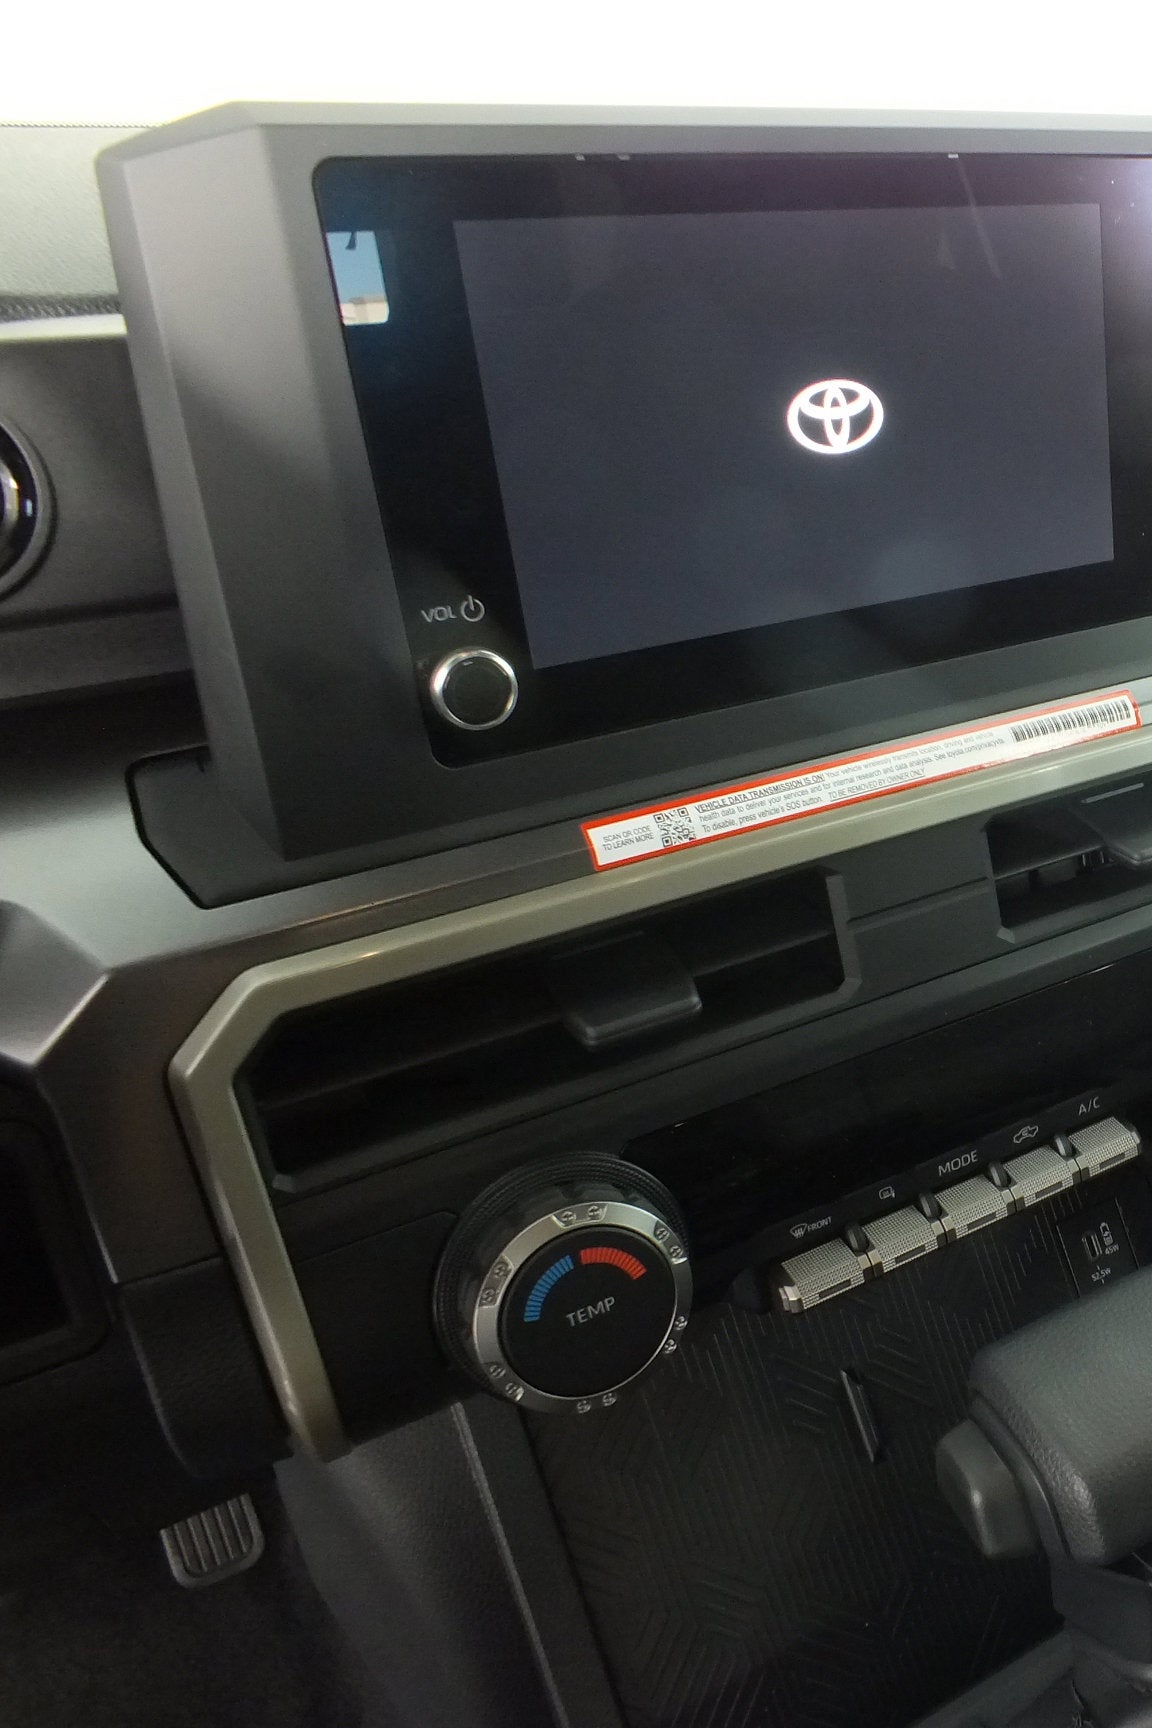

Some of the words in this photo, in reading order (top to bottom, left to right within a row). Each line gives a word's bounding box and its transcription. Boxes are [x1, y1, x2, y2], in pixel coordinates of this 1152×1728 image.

[421, 605, 457, 623] VOL
[695, 800, 729, 813] VEHICLE
[729, 794, 748, 808] DATA
[748, 779, 803, 800] TRANSMISSION
[803, 776, 811, 787] IS
[811, 772, 825, 784] ON!
[826, 770, 840, 779] Your
[840, 765, 862, 776] vehicle
[863, 756, 893, 770] wirelessly
[700, 810, 720, 824] health
[721, 806, 737, 818] data
[737, 804, 745, 814] to
[745, 799, 767, 811] deliver
[768, 796, 783, 807] your
[783, 787, 809, 799] services
[810, 784, 821, 794] and
[823, 781, 832, 791] for
[832, 775, 855, 788] internal
[856, 771, 882, 784] research
[883, 767, 894, 776] and
[895, 762, 908, 773] data
[934, 751, 947, 761] See
[829, 790, 838, 801] TO
[838, 788, 848, 798] BE
[847, 780, 878, 795] REMOVED
[878, 778, 887, 788] BY
[887, 771, 910, 784] OWNER
[910, 767, 926, 779] ONLY
[702, 822, 712, 834] To
[712, 818, 738, 832] disable,
[739, 814, 757, 828] press
[757, 805, 785, 820] vehicle's
[786, 800, 802, 812] SOS
[602, 832, 622, 844] SCAN
[622, 829, 634, 839] QR
[633, 825, 652, 837] CODE
[602, 842, 614, 852] TO
[613, 837, 636, 849] LEARN
[635, 832, 655, 844] MORE
[1078, 1096, 1101, 1117] A/C
[938, 1149, 979, 1177] MODE
[807, 1216, 832, 1232] FRONT
[1105, 1243, 1120, 1255] 45W
[565, 1296, 616, 1327] TEMP
